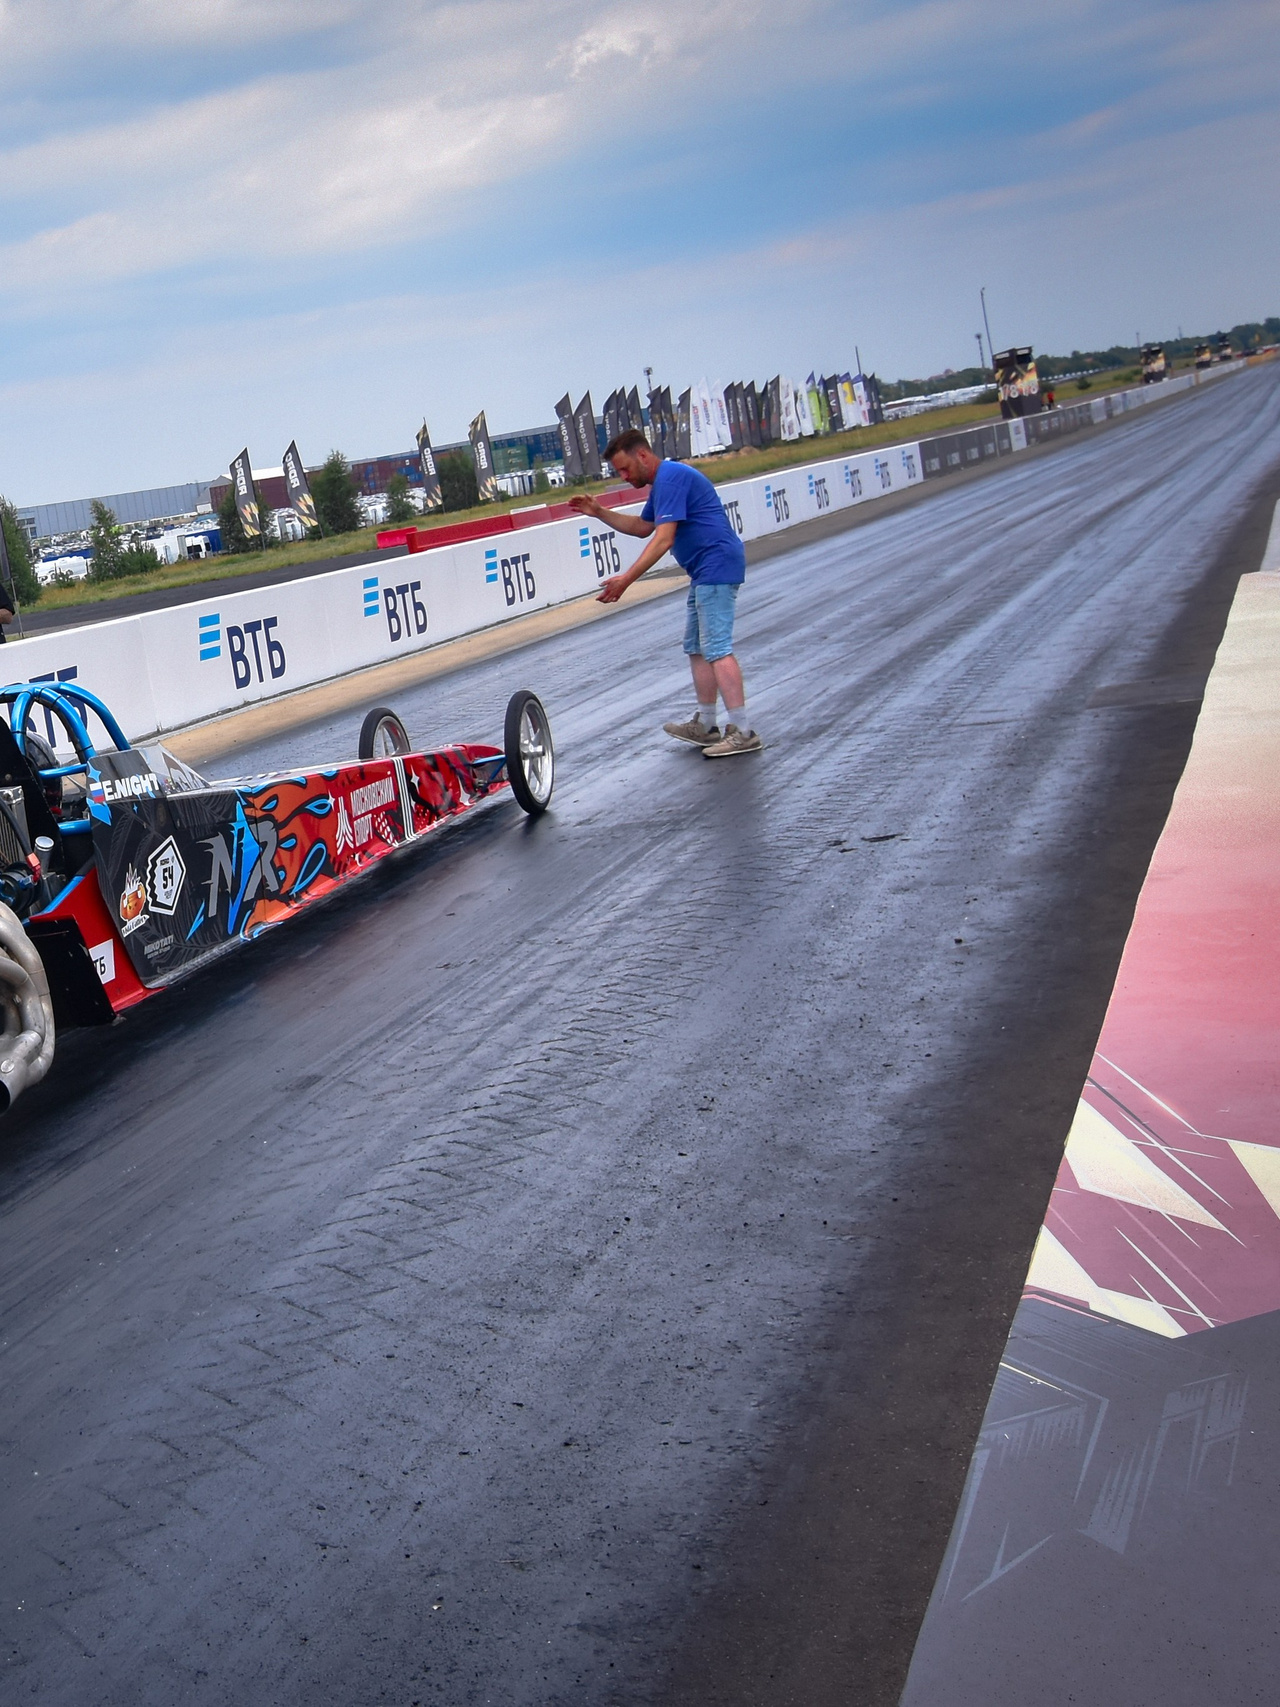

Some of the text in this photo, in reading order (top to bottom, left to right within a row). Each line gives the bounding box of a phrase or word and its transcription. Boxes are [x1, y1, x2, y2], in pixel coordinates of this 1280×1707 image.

[772, 489, 789, 523] ВТБ
[814, 478, 829, 509] ВТБ
[592, 531, 620, 578] ВТБ
[500, 553, 536, 606] ВТБ
[383, 580, 428, 642] ВТБ
[226, 616, 286, 690] ВТБ
[102, 773, 159, 801] E.NIGHT
[353, 813, 373, 847] СПОРТ
[162, 865, 174, 890] 54
